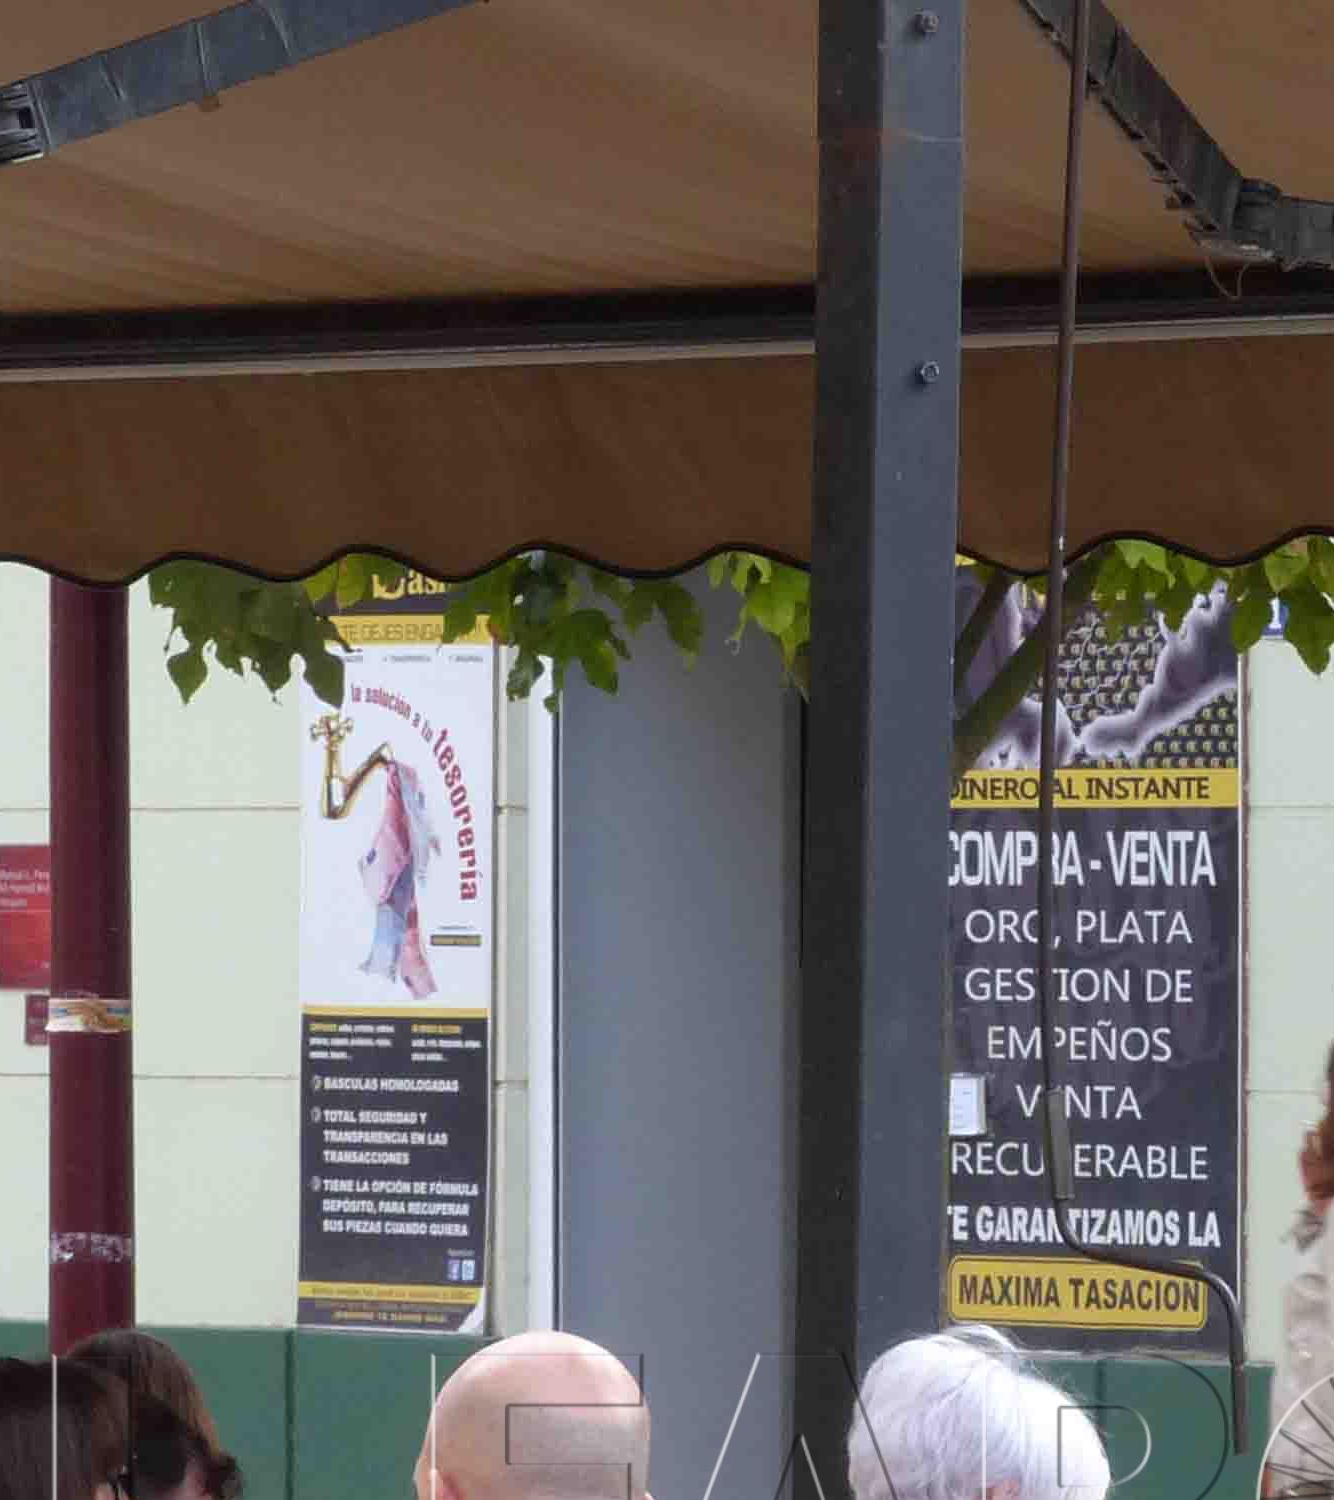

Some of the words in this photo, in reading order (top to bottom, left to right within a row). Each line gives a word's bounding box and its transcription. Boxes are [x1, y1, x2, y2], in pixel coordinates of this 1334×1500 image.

[1051, 777, 1080, 801] AL
[1086, 775, 1210, 801] INSTANTE
[432, 728, 484, 901] tesorería
[1106, 829, 1217, 887] VENTA
[1075, 909, 1194, 944] PLATA
[964, 967, 1130, 1003] GESION
[1145, 968, 1194, 1003] DE
[323, 1109, 357, 1123] TOTAL
[1016, 1084, 1142, 1120] VNTA
[323, 1129, 408, 1145] TRANSPARENCIA
[410, 1132, 425, 1145] EN
[427, 1132, 449, 1146] LAS
[323, 1150, 411, 1165] TRANSACCIONES
[950, 1141, 1209, 1181] RECUERABLE
[323, 1178, 354, 1193] TIENE
[355, 1179, 370, 1193] LA
[413, 1181, 428, 1195] DE
[323, 1218, 344, 1232] SUS
[345, 1219, 382, 1234] PIEZAS
[378, 1200, 406, 1215] PARA
[407, 1201, 470, 1217] RECUPERAR
[1188, 1211, 1221, 1248] LA
[958, 1273, 1061, 1308] MAXIMA
[1069, 1276, 1201, 1313] TASACION
